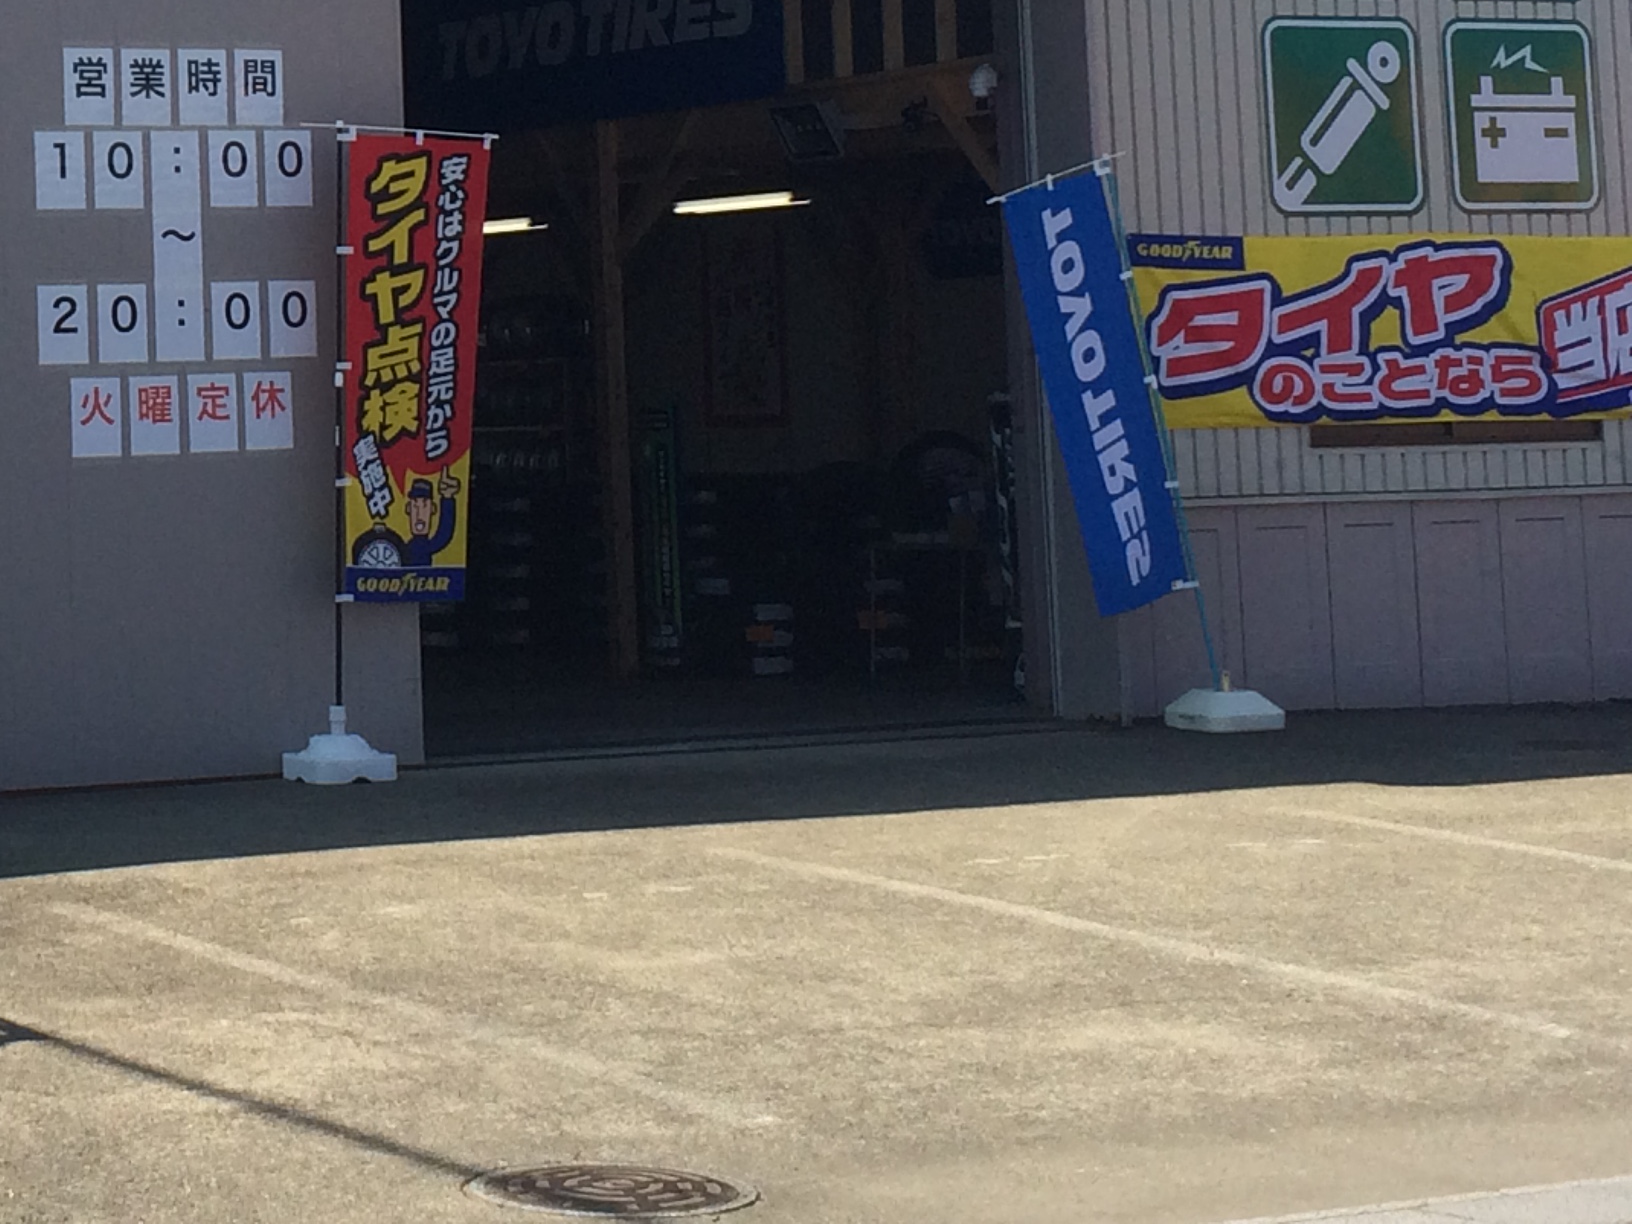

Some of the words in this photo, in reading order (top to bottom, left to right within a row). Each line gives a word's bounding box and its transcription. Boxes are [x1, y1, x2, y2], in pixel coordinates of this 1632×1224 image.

[439, 1, 569, 79] TOYO
[73, 56, 277, 99] 営業時間
[52, 141, 304, 179] 10:00
[1137, 241, 1233, 262] GOODYEAR
[52, 291, 308, 334] 20:00
[362, 155, 428, 443] タイヤ点検
[426, 156, 468, 459] 安心はクルマの足元から
[1154, 252, 1498, 382] タイヤ
[1257, 353, 1542, 406] のことなら
[80, 380, 287, 426] 火曜定休
[357, 574, 450, 594] GOODYEAR
